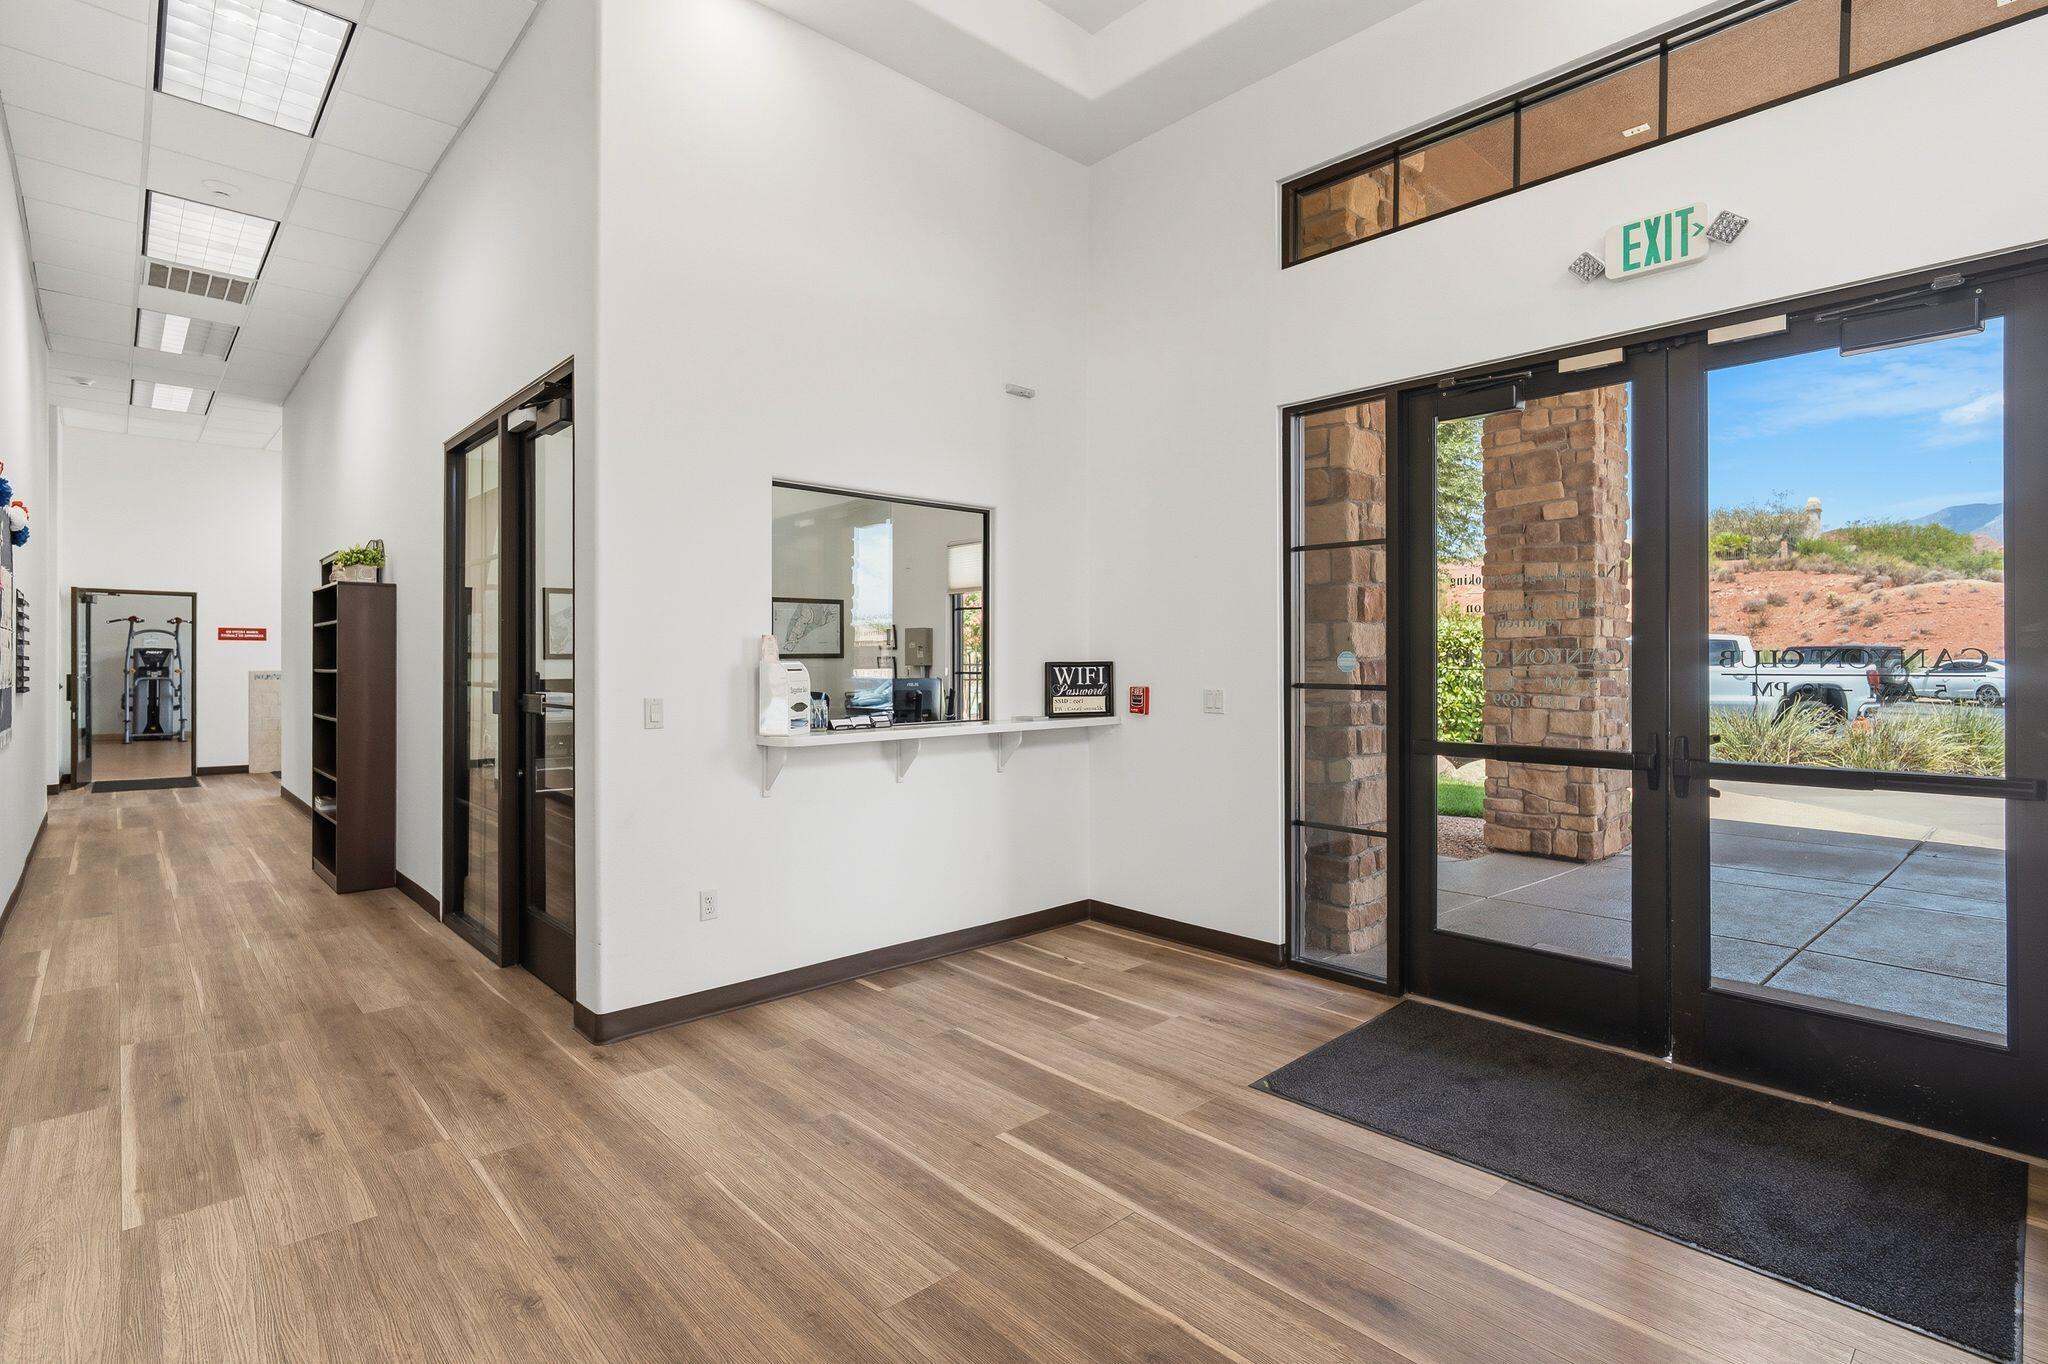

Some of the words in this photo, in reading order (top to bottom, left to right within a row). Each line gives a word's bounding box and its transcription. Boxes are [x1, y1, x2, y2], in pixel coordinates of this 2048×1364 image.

[1622, 206, 1695, 273] EXIT
[1053, 666, 1105, 686] WIFI
[1052, 683, 1108, 697] Password
